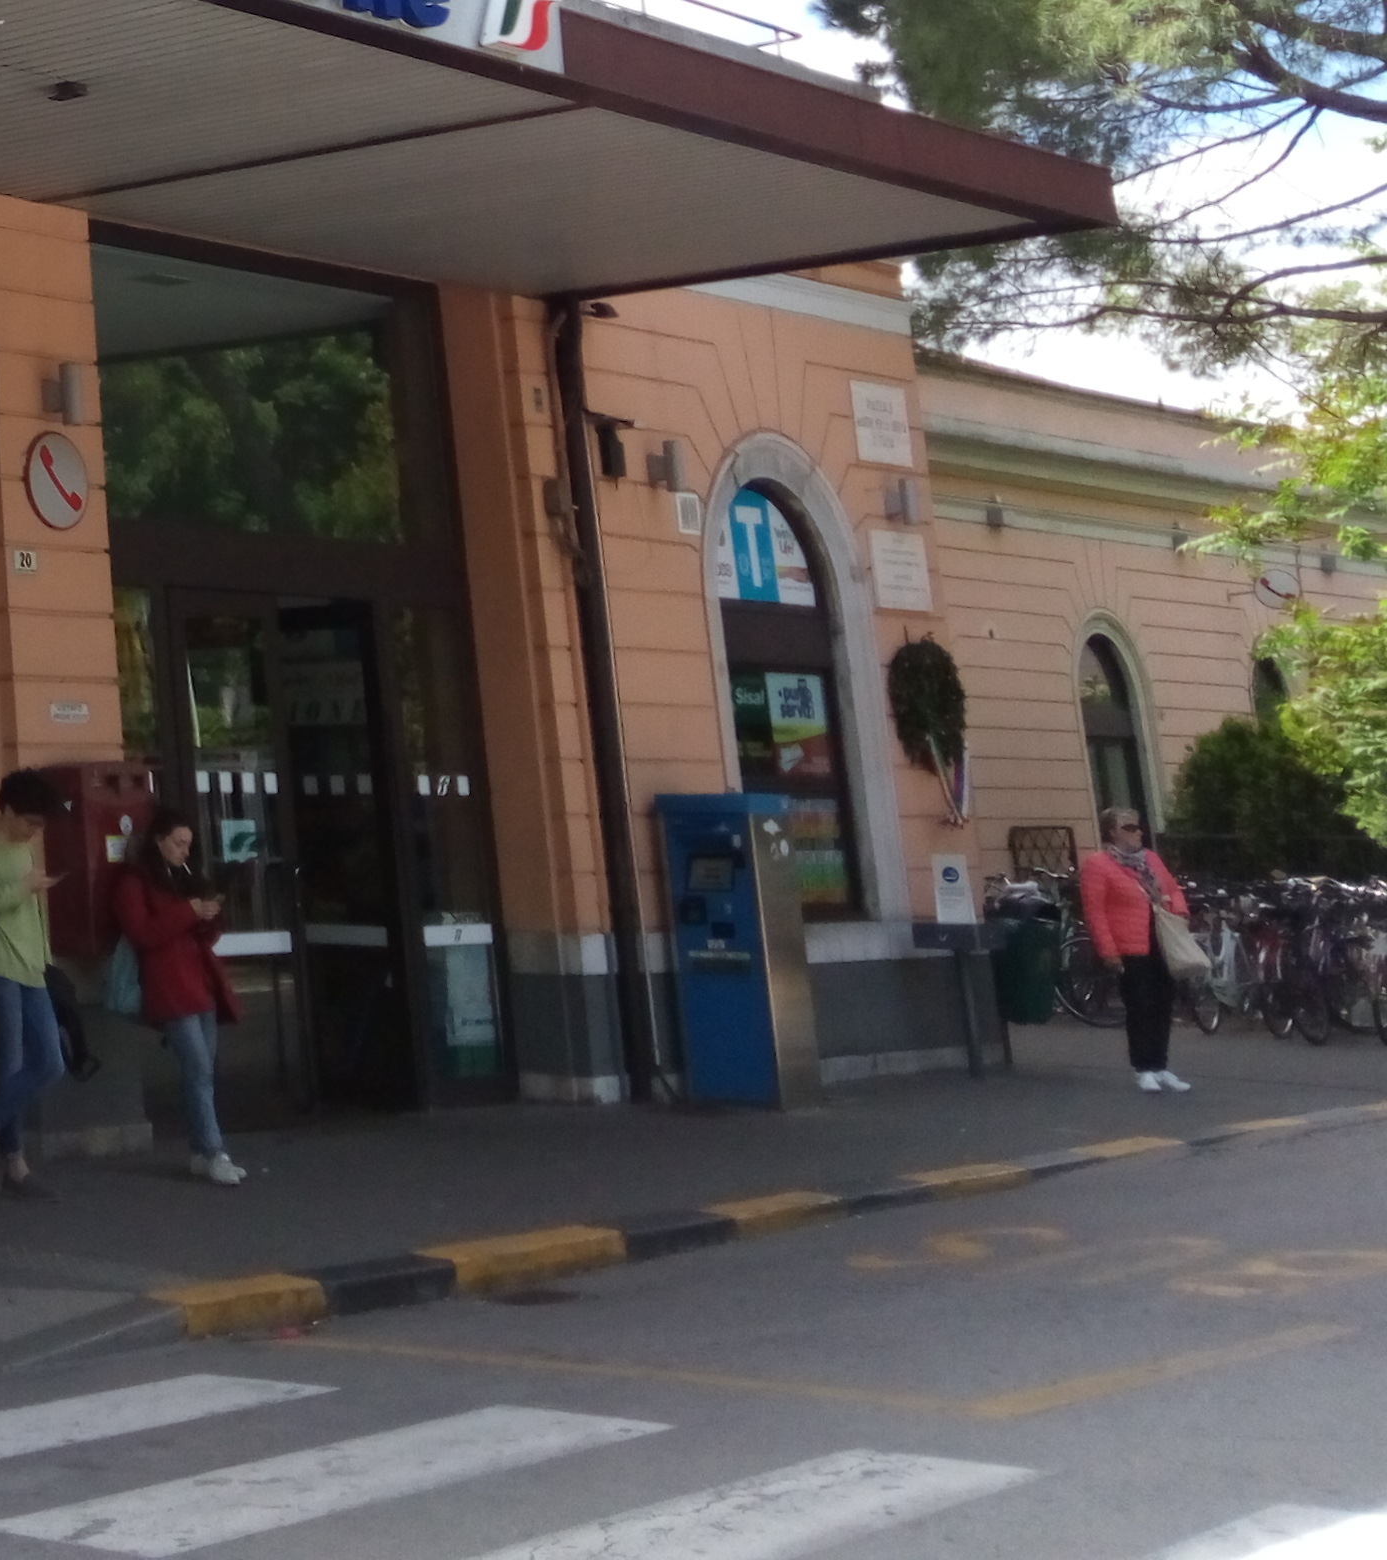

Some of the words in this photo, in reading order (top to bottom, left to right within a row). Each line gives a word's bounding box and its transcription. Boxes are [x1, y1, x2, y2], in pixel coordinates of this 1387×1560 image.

[735, 505, 763, 588] T
[19, 551, 32, 568] 20
[735, 687, 765, 705] Sisal
